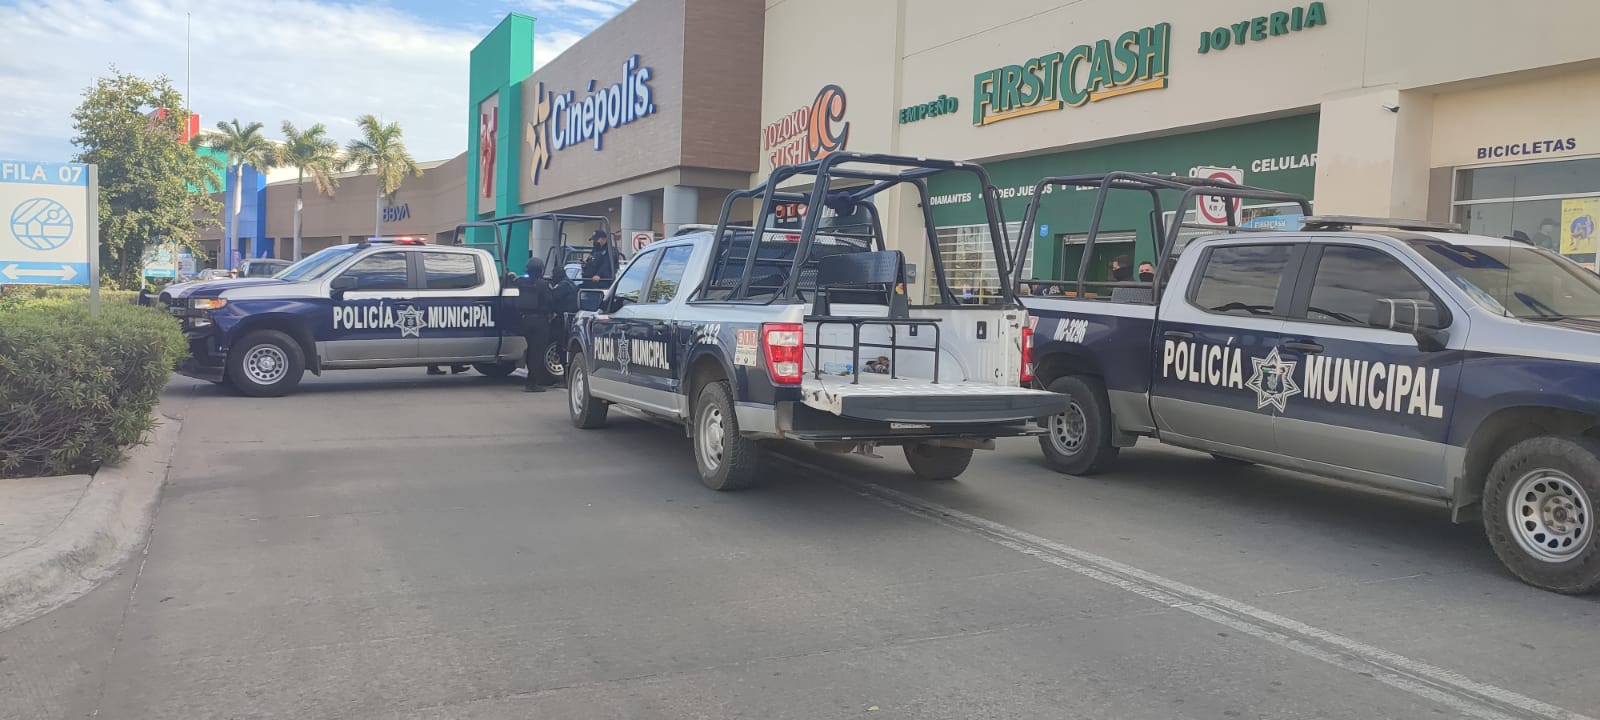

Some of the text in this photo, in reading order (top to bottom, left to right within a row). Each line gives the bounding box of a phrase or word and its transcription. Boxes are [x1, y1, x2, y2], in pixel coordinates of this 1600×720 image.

[1197, 2, 1327, 53] JOYERIA
[973, 23, 1170, 126] FIRSTCASH
[899, 95, 959, 124] EMPEÑO
[763, 106, 810, 151] YOZOKO
[1251, 153, 1318, 173] CELULAR
[1477, 138, 1577, 159] BICICLETAS
[2, 163, 82, 182] FILA 07
[930, 193, 972, 206] DIAMANTES
[333, 302, 495, 329] POLICÍA MUNICIPAL
[631, 338, 670, 370] MUNICIPAL
[1163, 337, 1443, 418] POLICÍA MUNICIPAL
